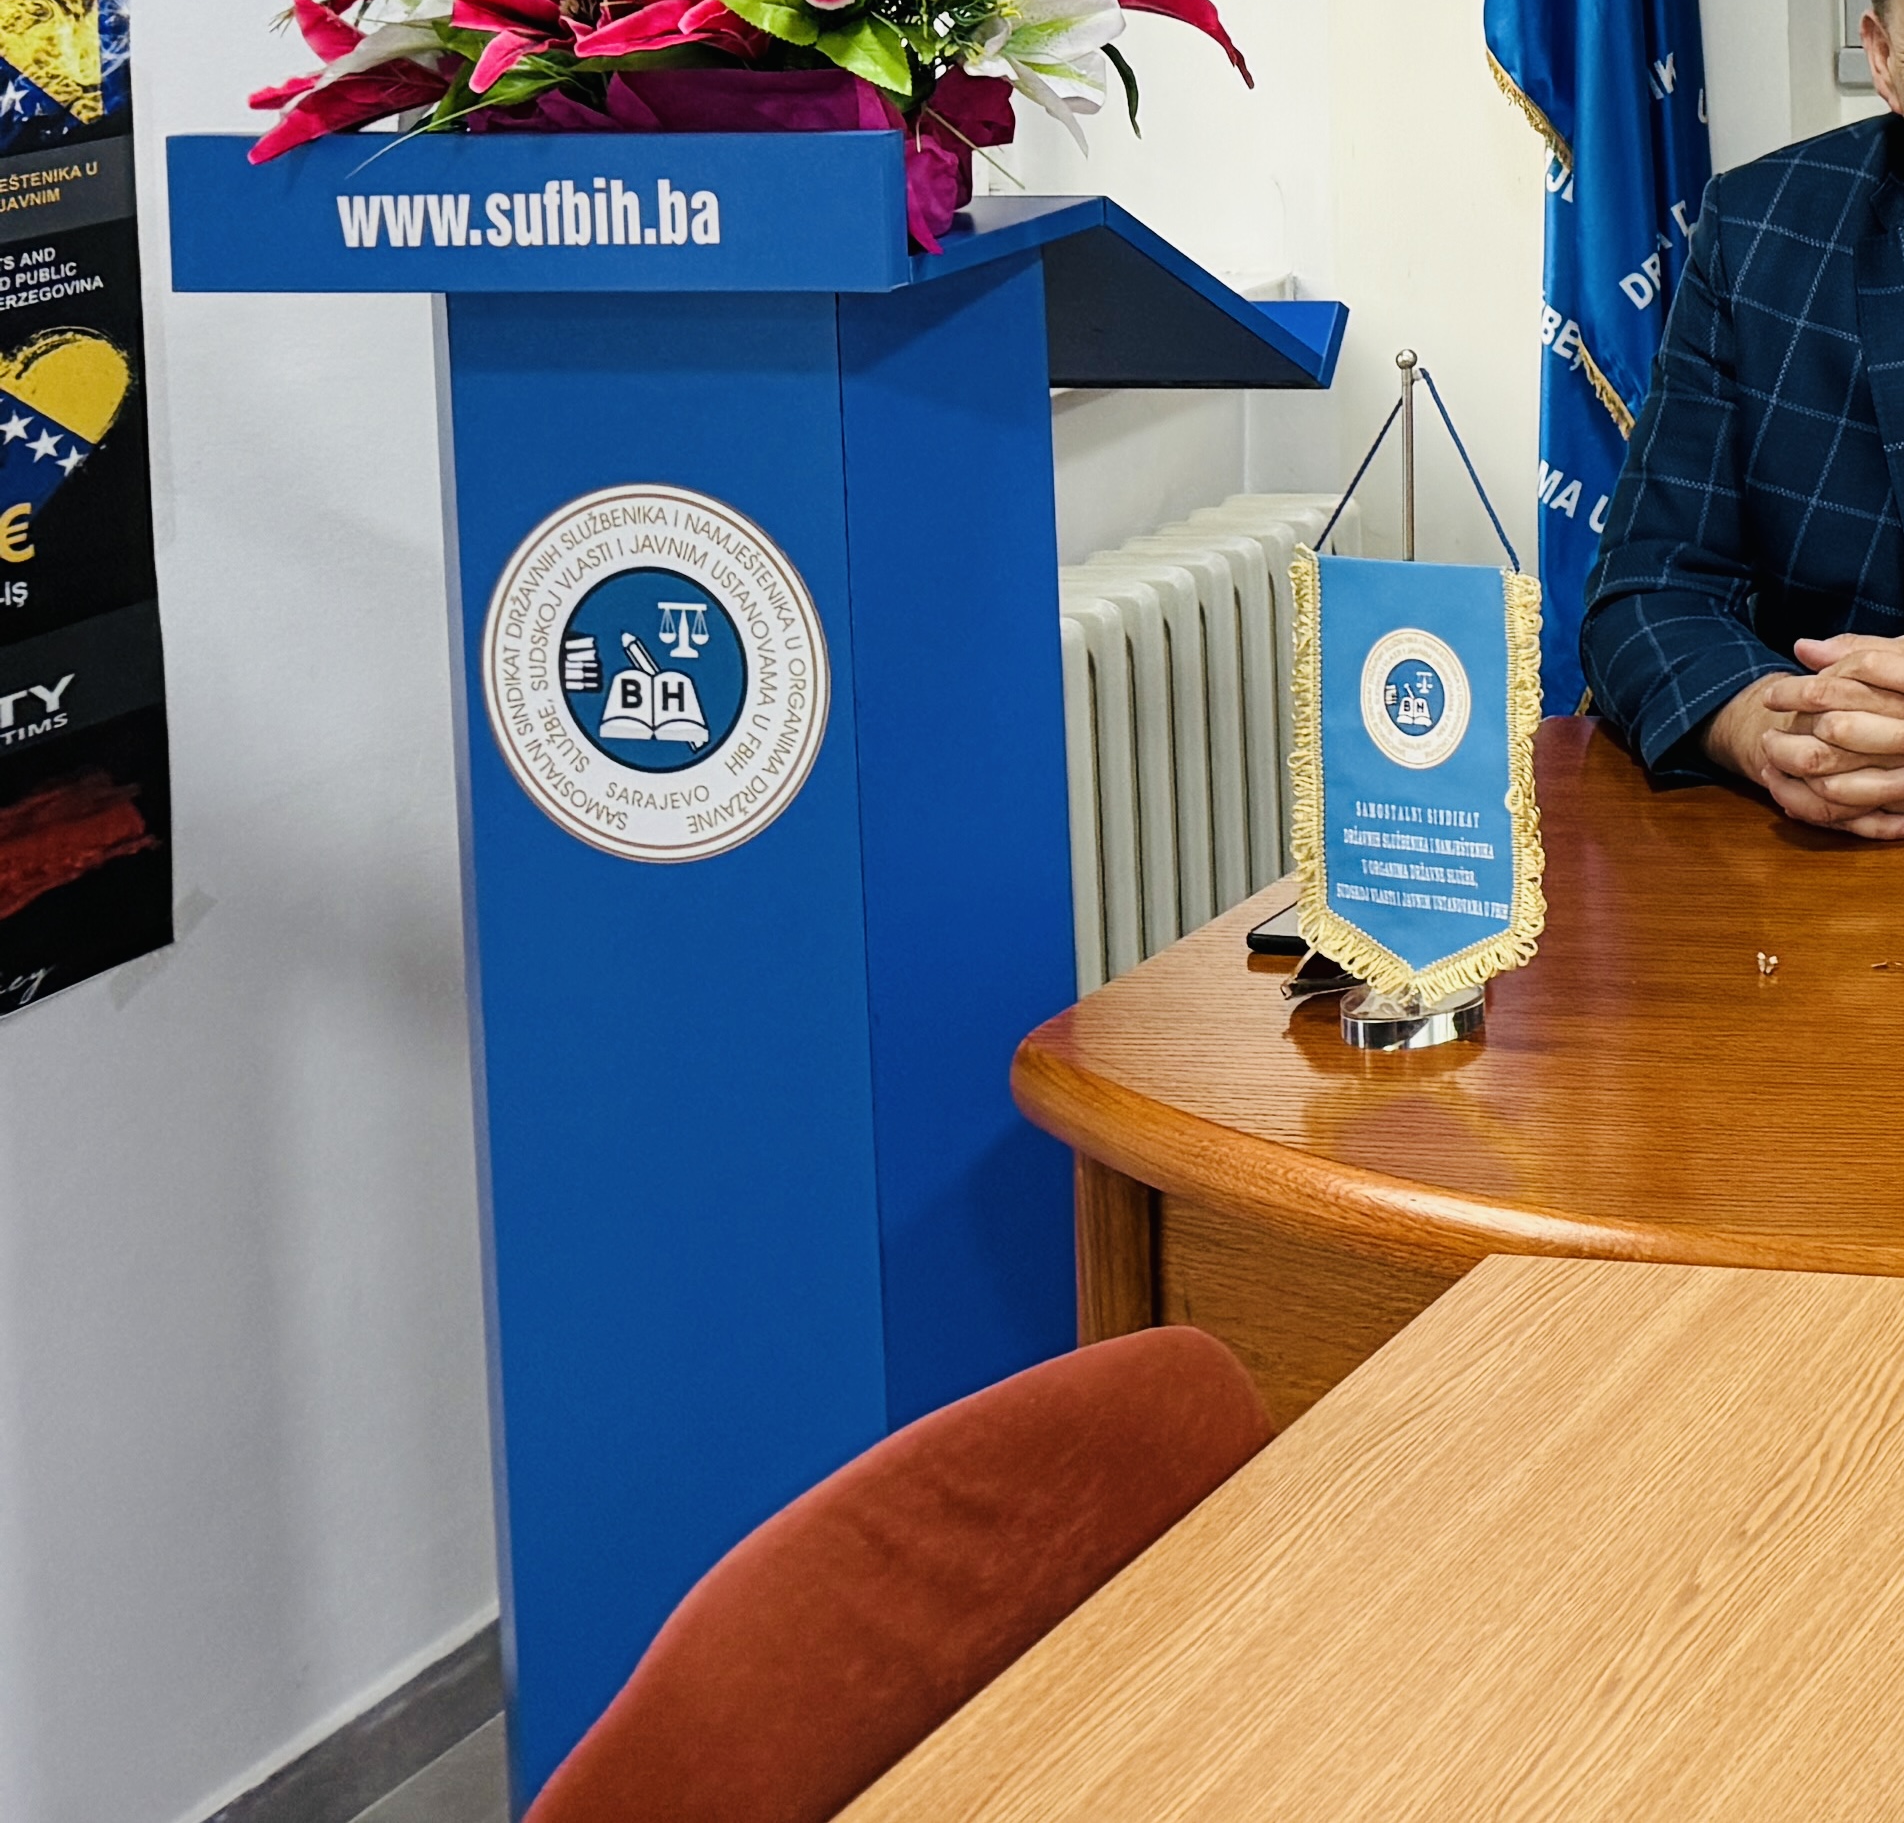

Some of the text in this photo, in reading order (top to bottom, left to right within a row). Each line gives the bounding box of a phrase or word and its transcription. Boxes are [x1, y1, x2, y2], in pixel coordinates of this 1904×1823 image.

[86, 161, 98, 176] U
[337, 177, 720, 247] www.sufbih.ba
[20, 247, 56, 268] AND
[15, 261, 77, 288] PUBLIC
[503, 506, 807, 834] SAMOSTALNI SINDIKAT DRŽAVNIH SLUŽBENIKA I NAMJEŠTENIKA U ORGANIMA DRŽAVNE
[529, 534, 778, 777] SLUŽBE, SUDSKOJ VLASTI I JAVNIM USTANOVAMA U FBIH
[621, 679, 685, 712] B H
[606, 781, 710, 810] SARAJEVO
[1356, 800, 1423, 824] SAMOSTALNI
